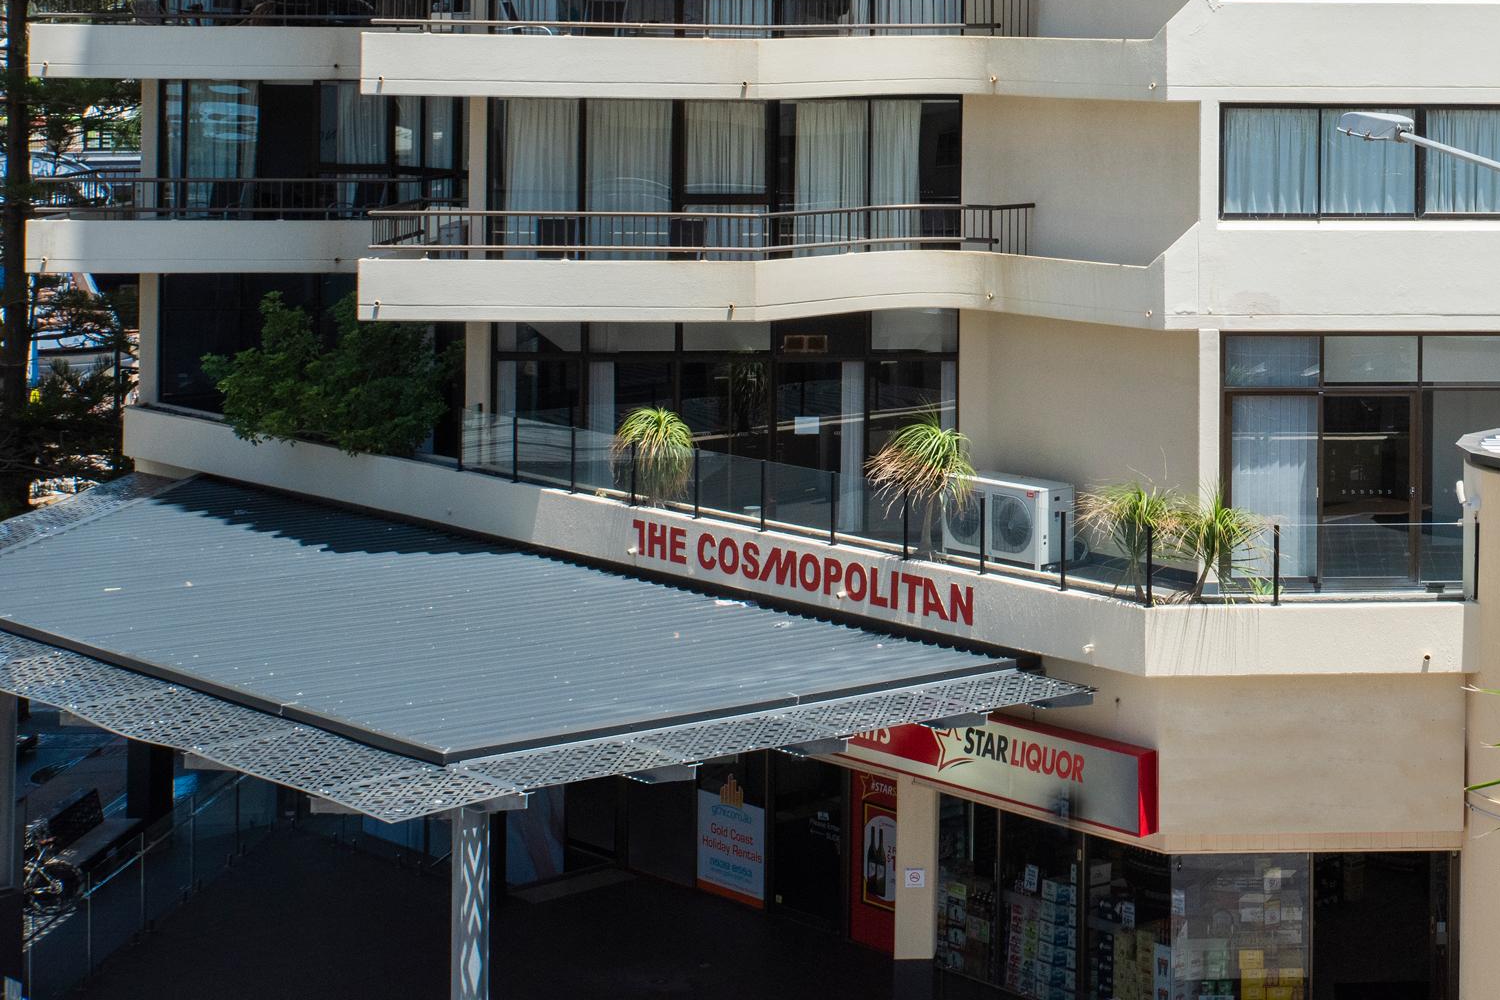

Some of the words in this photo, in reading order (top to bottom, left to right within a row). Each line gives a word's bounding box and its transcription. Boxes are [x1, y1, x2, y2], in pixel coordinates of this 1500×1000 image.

[632, 519, 687, 565] THE
[696, 532, 975, 627] COSMOPOLITAN
[963, 727, 1009, 763] STAR
[1010, 738, 1085, 783] LIQUOR
[702, 834, 729, 856] Holiday
[732, 844, 763, 864] Rentals
[710, 822, 728, 838] Gold
[730, 828, 753, 846] Coast
